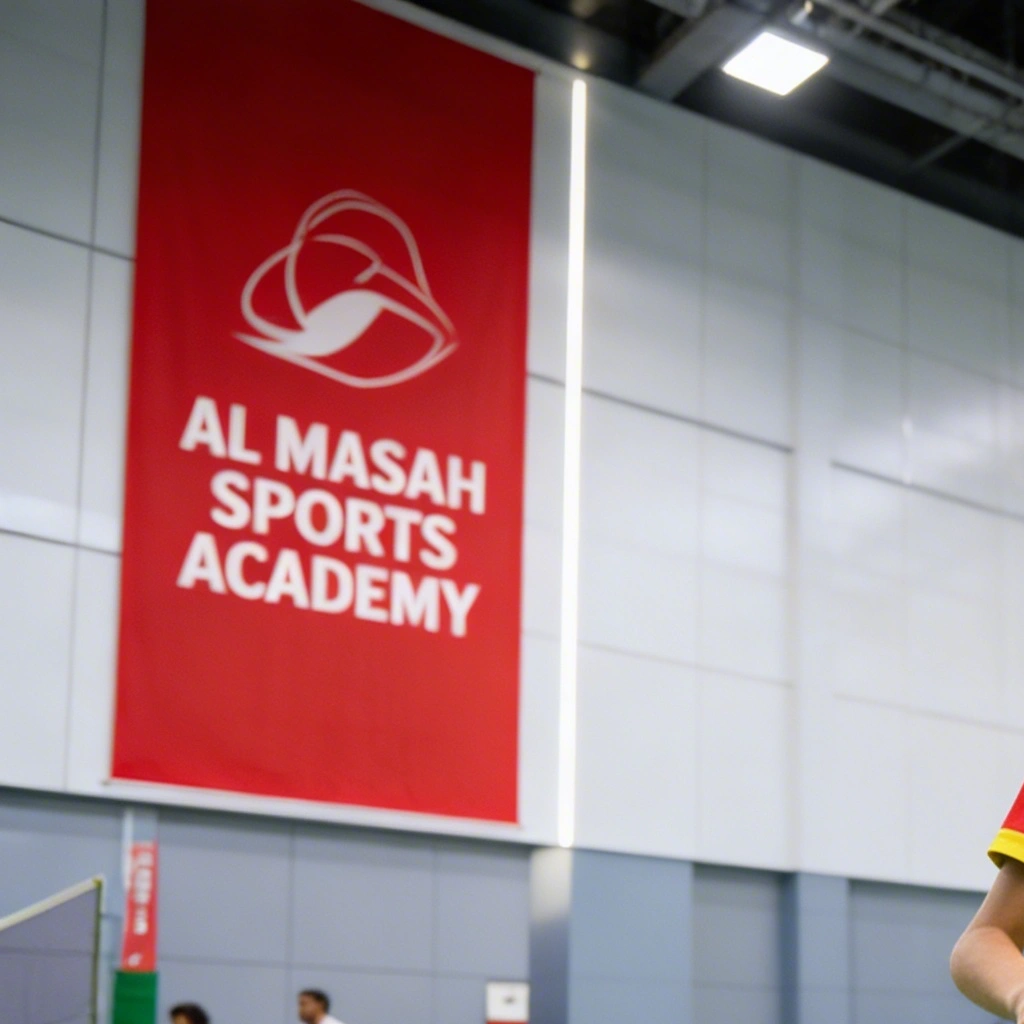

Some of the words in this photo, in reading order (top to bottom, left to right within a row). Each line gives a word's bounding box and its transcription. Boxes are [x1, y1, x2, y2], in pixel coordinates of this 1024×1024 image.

[180, 397, 262, 466] AL
[274, 415, 487, 516] MASAH
[210, 470, 459, 572] SPORTS
[176, 532, 482, 639] ACADEMY
